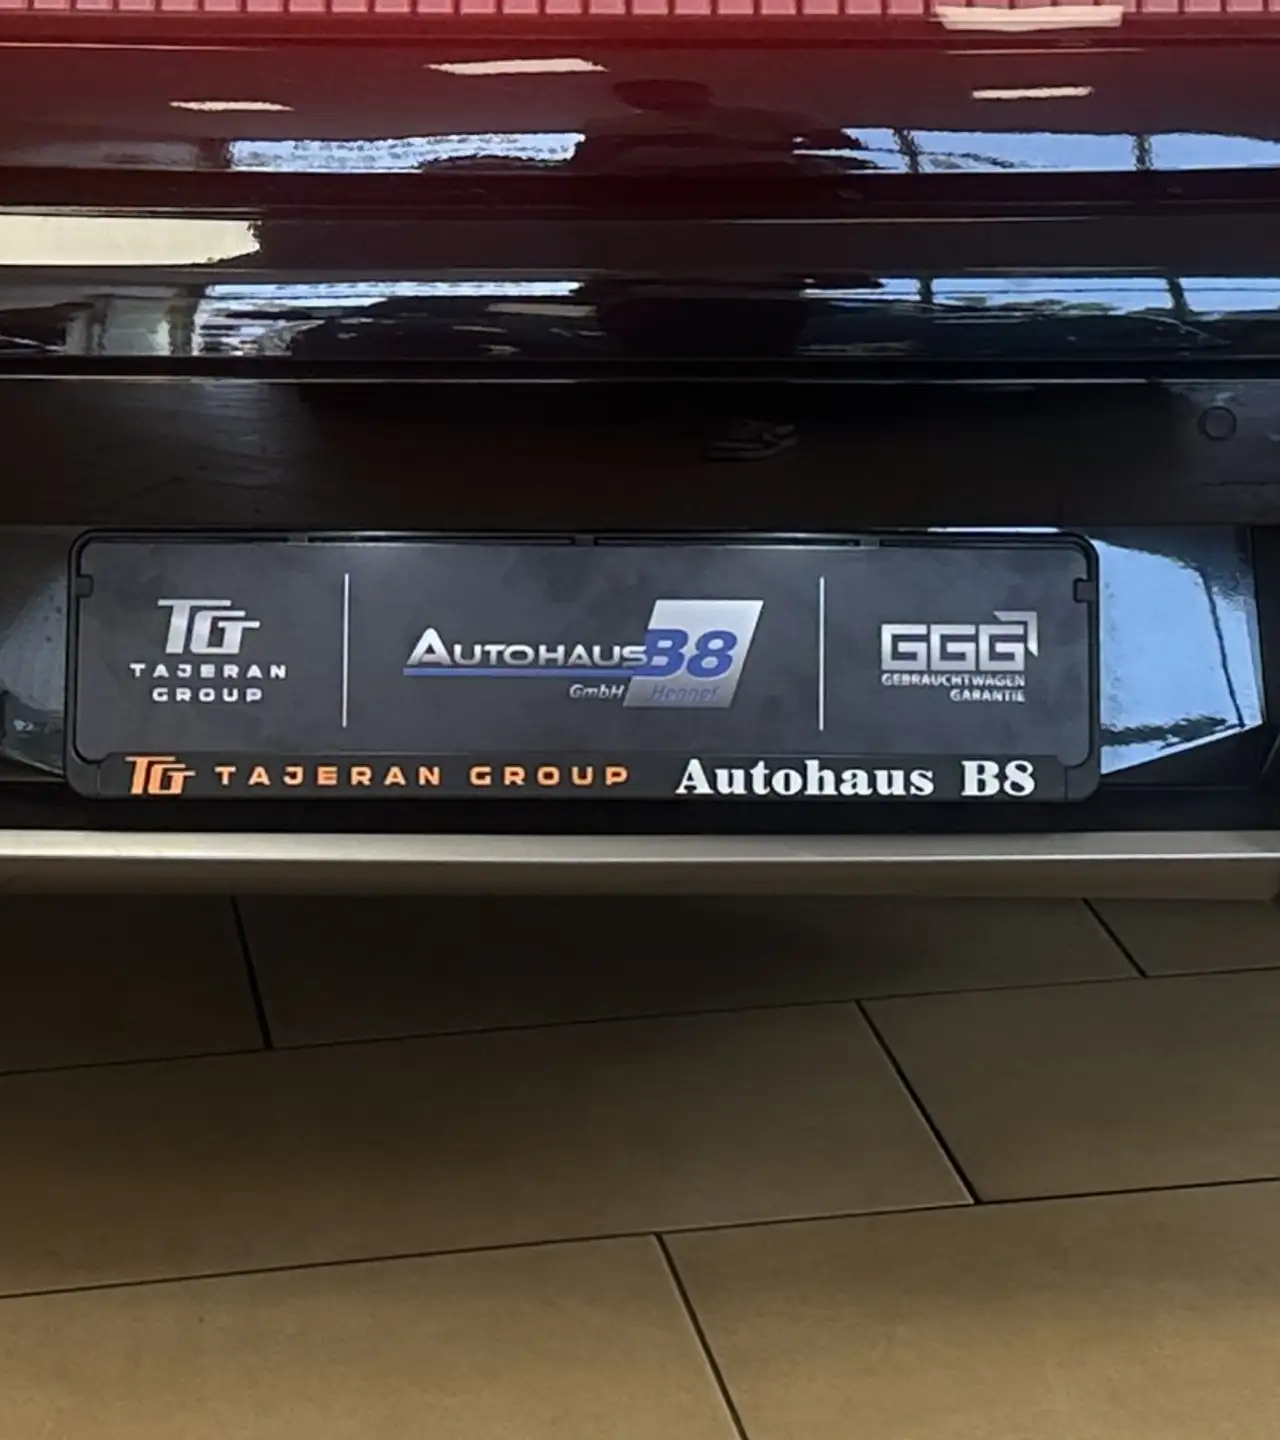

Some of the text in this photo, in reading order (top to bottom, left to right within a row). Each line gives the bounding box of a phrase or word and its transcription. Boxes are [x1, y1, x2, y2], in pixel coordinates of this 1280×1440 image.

[405, 627, 739, 679] AUTOHAUS B8
[880, 623, 1026, 672] GGG
[129, 662, 288, 680] TAJERAN
[880, 672, 1026, 687] GEBRAUCHTWAGEN
[151, 687, 263, 703] GROUP
[568, 683, 626, 700] GmbH
[948, 689, 1026, 703] GARANTIE
[214, 765, 442, 787] TAJERAN
[469, 765, 630, 787] GROUP
[674, 757, 935, 797] Autohaus
[960, 759, 1036, 797] B8
